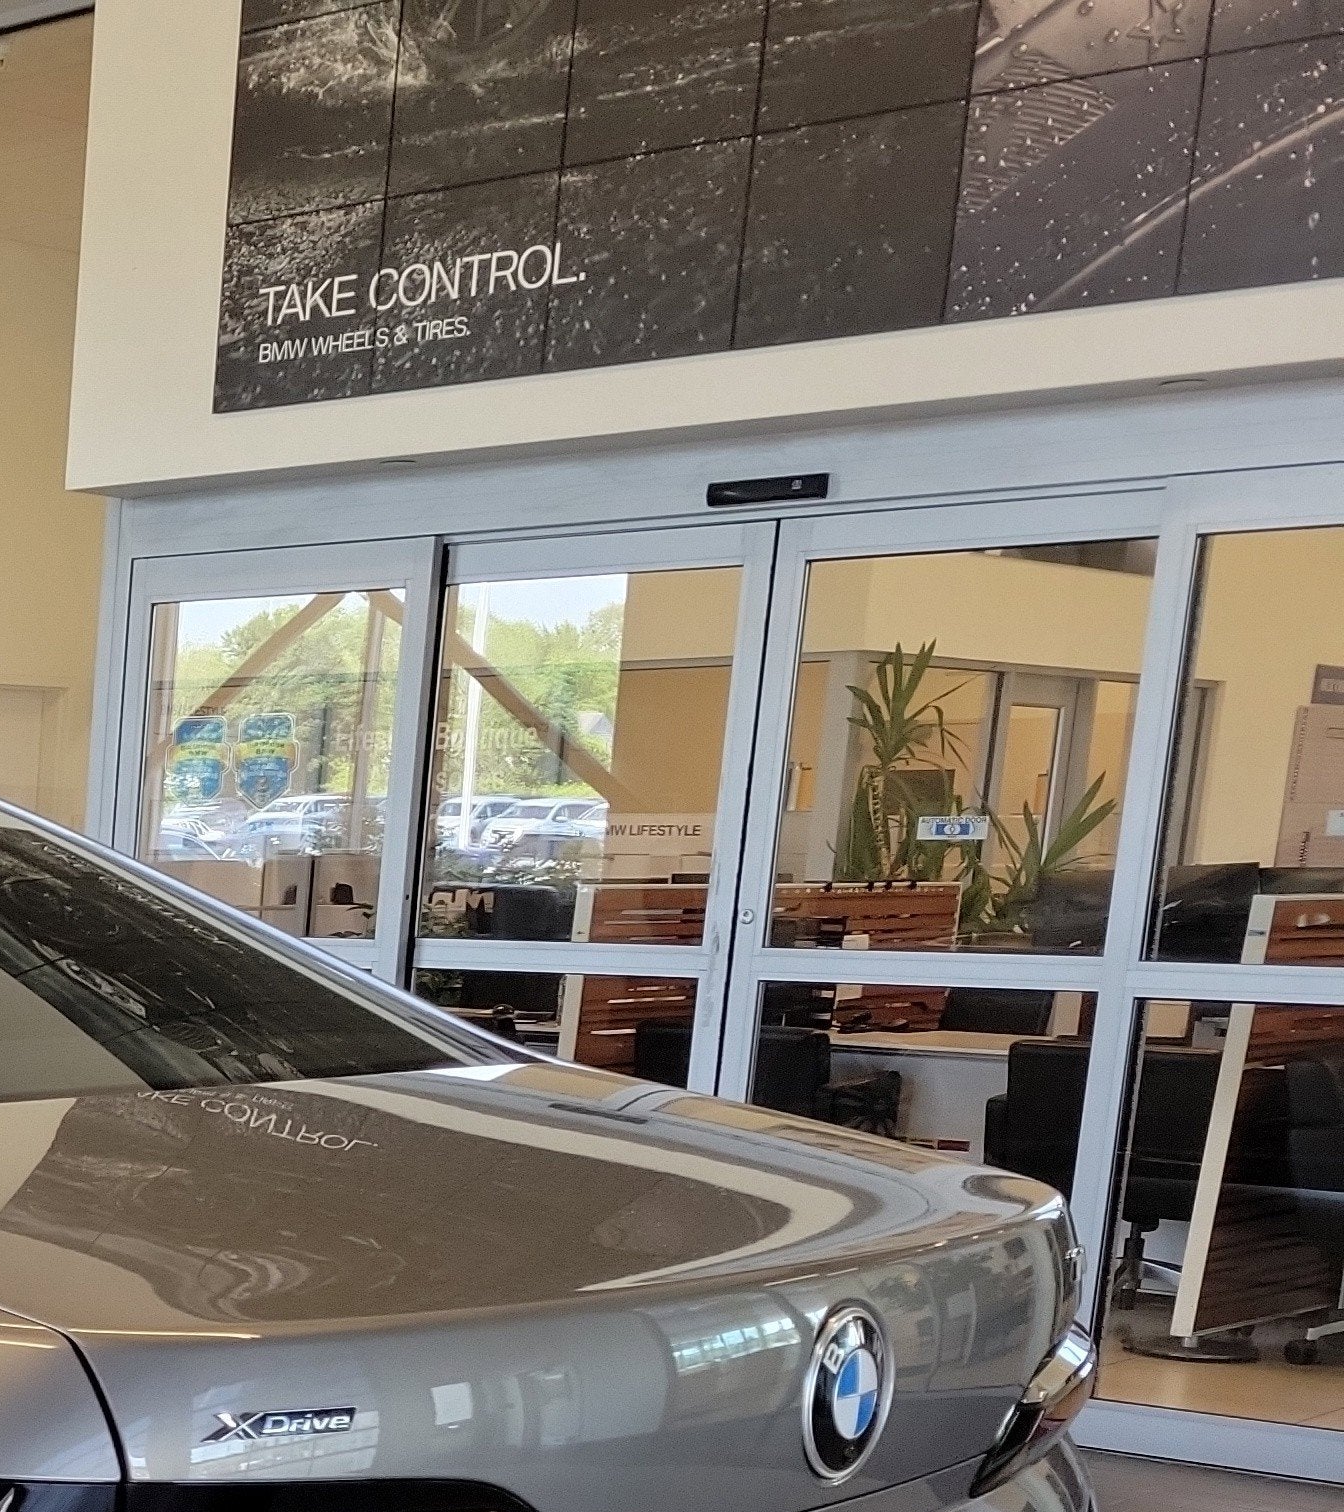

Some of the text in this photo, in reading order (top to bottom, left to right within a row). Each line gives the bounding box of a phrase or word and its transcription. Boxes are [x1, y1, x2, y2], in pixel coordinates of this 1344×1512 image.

[259, 242, 586, 326] TAKE CONTROL.
[259, 316, 471, 363] BMW WHEELS & TIRES.
[629, 824, 701, 837] LIFESTYLE
